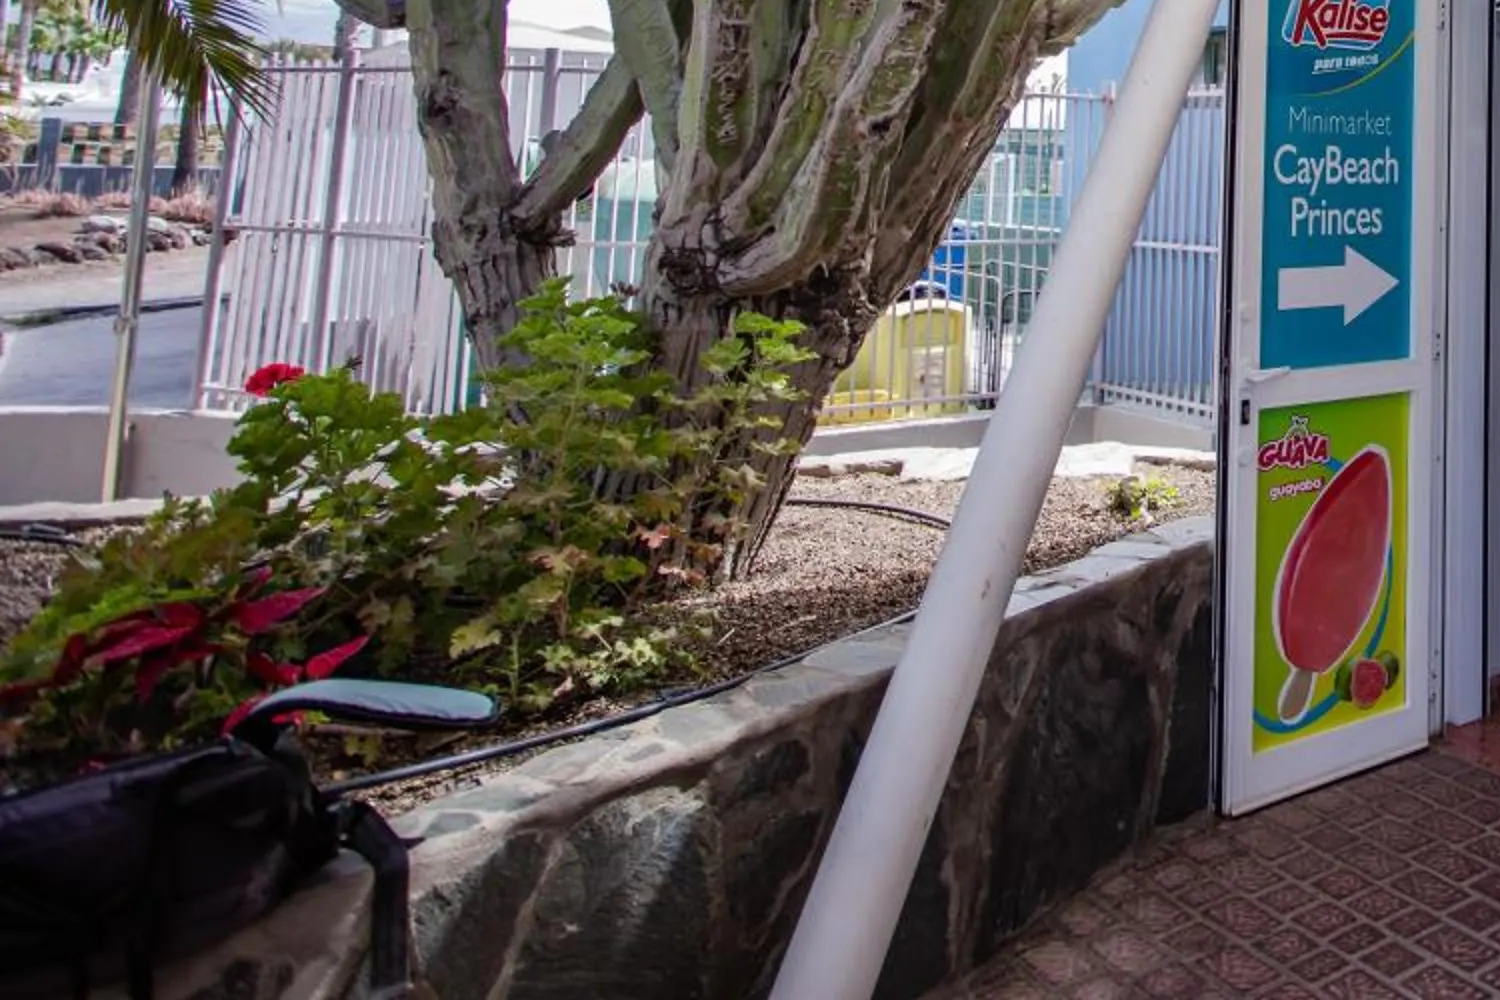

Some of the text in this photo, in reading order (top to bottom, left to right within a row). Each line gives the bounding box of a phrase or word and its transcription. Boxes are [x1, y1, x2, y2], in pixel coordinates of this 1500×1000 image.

[1288, 105, 1393, 137] Minimarket
[1273, 143, 1400, 196] CayBeach
[1290, 198, 1383, 238] Princes
